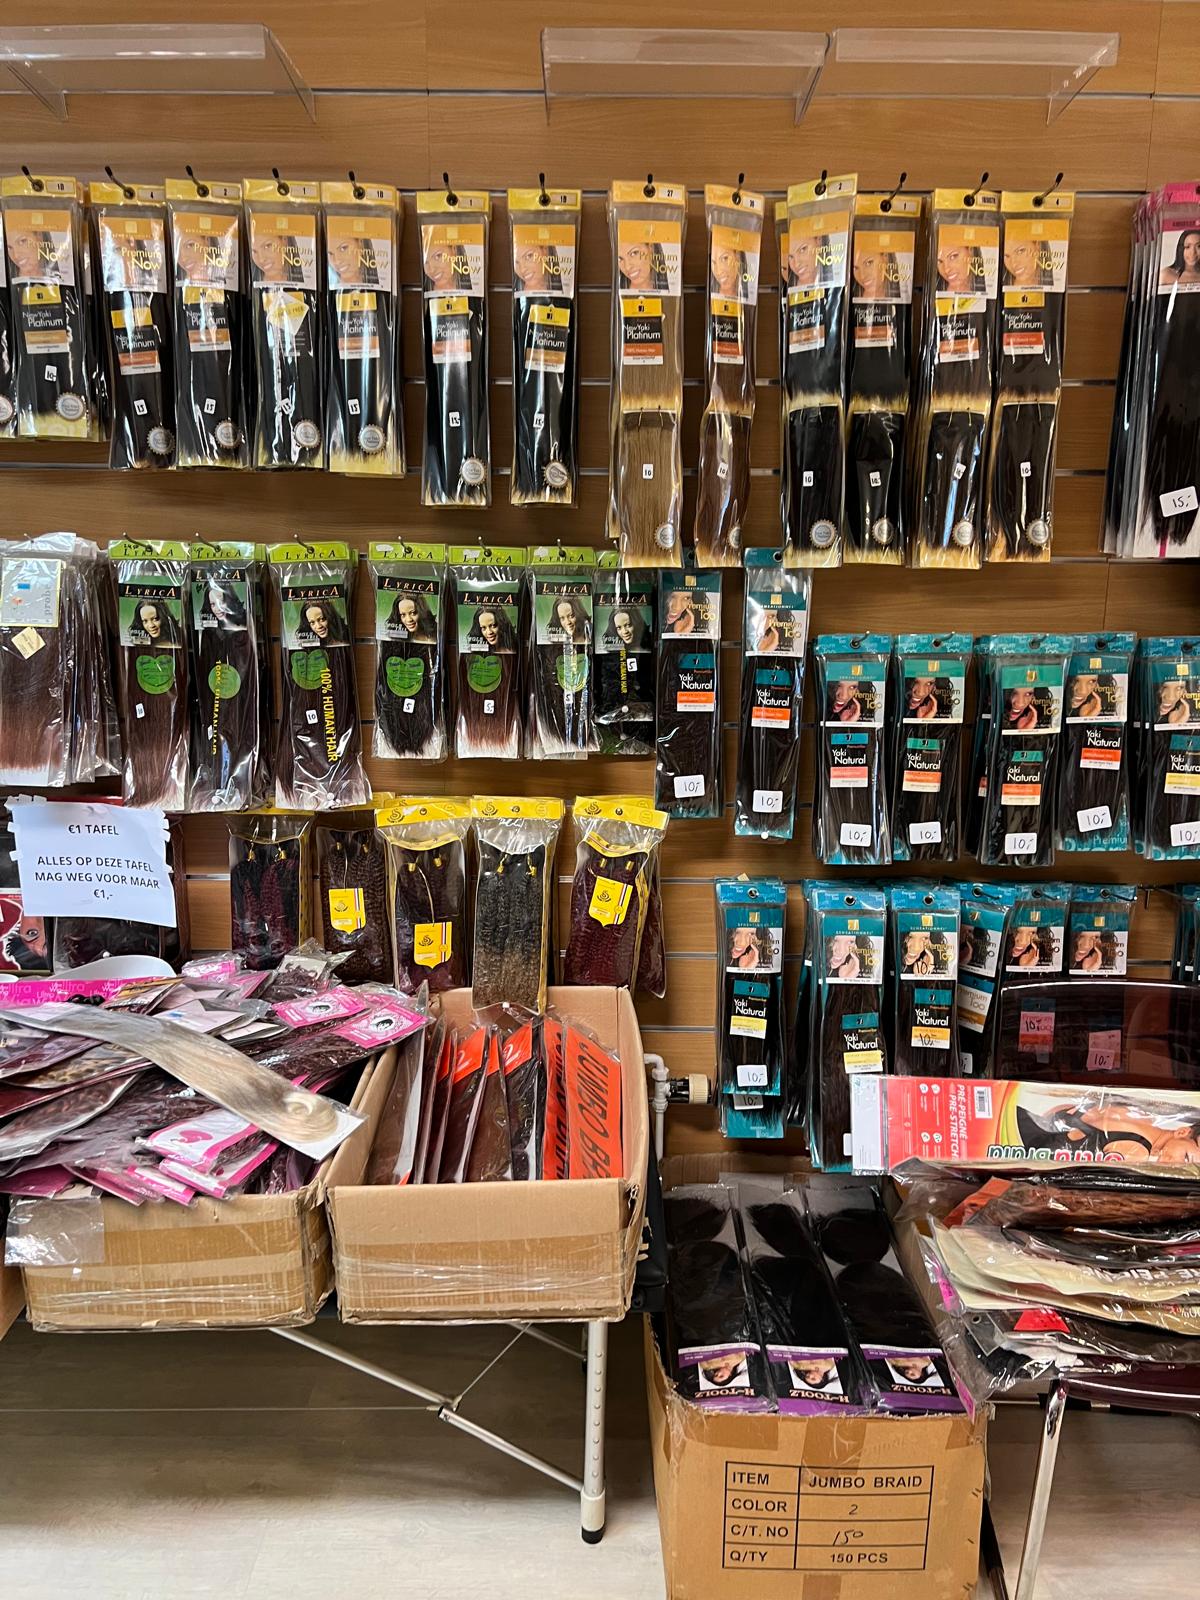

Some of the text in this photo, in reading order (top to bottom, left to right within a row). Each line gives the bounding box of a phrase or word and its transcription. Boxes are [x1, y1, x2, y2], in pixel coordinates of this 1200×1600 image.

[121, 247, 161, 259] Premium
[441, 253, 481, 263] Premium
[532, 252, 572, 263] Premium
[815, 251, 844, 267] Now
[132, 257, 160, 270] Now
[451, 262, 481, 275] Now
[542, 262, 572, 276] Now
[650, 261, 678, 274] Now
[1034, 258, 1065, 271] Now
[881, 268, 911, 283] Now
[28, 318, 64, 328] Platinum
[793, 314, 824, 326] Platinum
[1008, 320, 1043, 329] Platinum
[436, 328, 469, 337] Platinum
[627, 330, 661, 340] Platinum
[942, 327, 977, 337] Platinum
[1172, 494, 1192, 509] 15,-
[383, 578, 435, 592] LYRICA
[542, 583, 588, 594] LYRICA
[125, 586, 177, 598] LYRICA
[288, 585, 340, 599] LYRICA
[463, 592, 514, 604] LYRICA
[700, 609, 717, 621] Too
[784, 628, 801, 639] Too
[678, 672, 694, 682] Yaki
[681, 679, 713, 690] Natural
[756, 688, 771, 698] Yaki
[1107, 692, 1124, 704] Too
[757, 696, 790, 707] Natural
[866, 699, 883, 710] Too
[943, 695, 961, 706] Too
[320, 667, 338, 762] 100% HUMAN HAIR
[1043, 704, 1060, 716] Too
[1086, 730, 1102, 739] Yaki
[1087, 734, 1120, 748] Natural
[832, 748, 847, 757] Yaki
[906, 752, 922, 762] Yaki
[834, 754, 867, 765] Natural
[908, 759, 941, 770] Natural
[1170, 754, 1185, 764] Yaki
[1171, 759, 1200, 772] Natura
[1007, 770, 1040, 782] Natural
[684, 781, 701, 793] 10,-
[761, 796, 779, 808] 10,-
[1086, 812, 1106, 826] 10,-
[68, 824, 119, 836] €1 TAFEL
[919, 830, 937, 841] 10,-
[848, 831, 867, 843] 10,-
[1013, 837, 1034, 850] 10,-
[37, 856, 154, 873] ALLES OP DEZE TAFEL
[35, 872, 160, 889] MAG WEG VOOR MAAR
[93, 889, 113, 900] €1,-
[923, 941, 955, 951] Premium
[864, 955, 880, 967] Too
[938, 950, 954, 962] Too
[734, 998, 748, 1007] Yaki
[970, 1000, 985, 1011] Too
[735, 1005, 766, 1017] Natural
[915, 1008, 930, 1017] Yaki
[917, 1014, 949, 1027] Natural
[844, 1032, 859, 1042] Yaki
[847, 1038, 878, 1050] Natural
[747, 1071, 764, 1083] 10,-
[577, 1041, 610, 1140] JUMBO
[694, 1388, 756, 1399] H-TOOLZ
[891, 1383, 951, 1396] H-TOOLZ
[789, 1389, 849, 1404] H-TOOLZ
[732, 1471, 923, 1489] ITEM JUMBO BRAID
[731, 1498, 859, 1516] COLOR 2
[730, 1524, 789, 1538] C/T. NO
[729, 1550, 888, 1564] Q/TY 150 PCS
